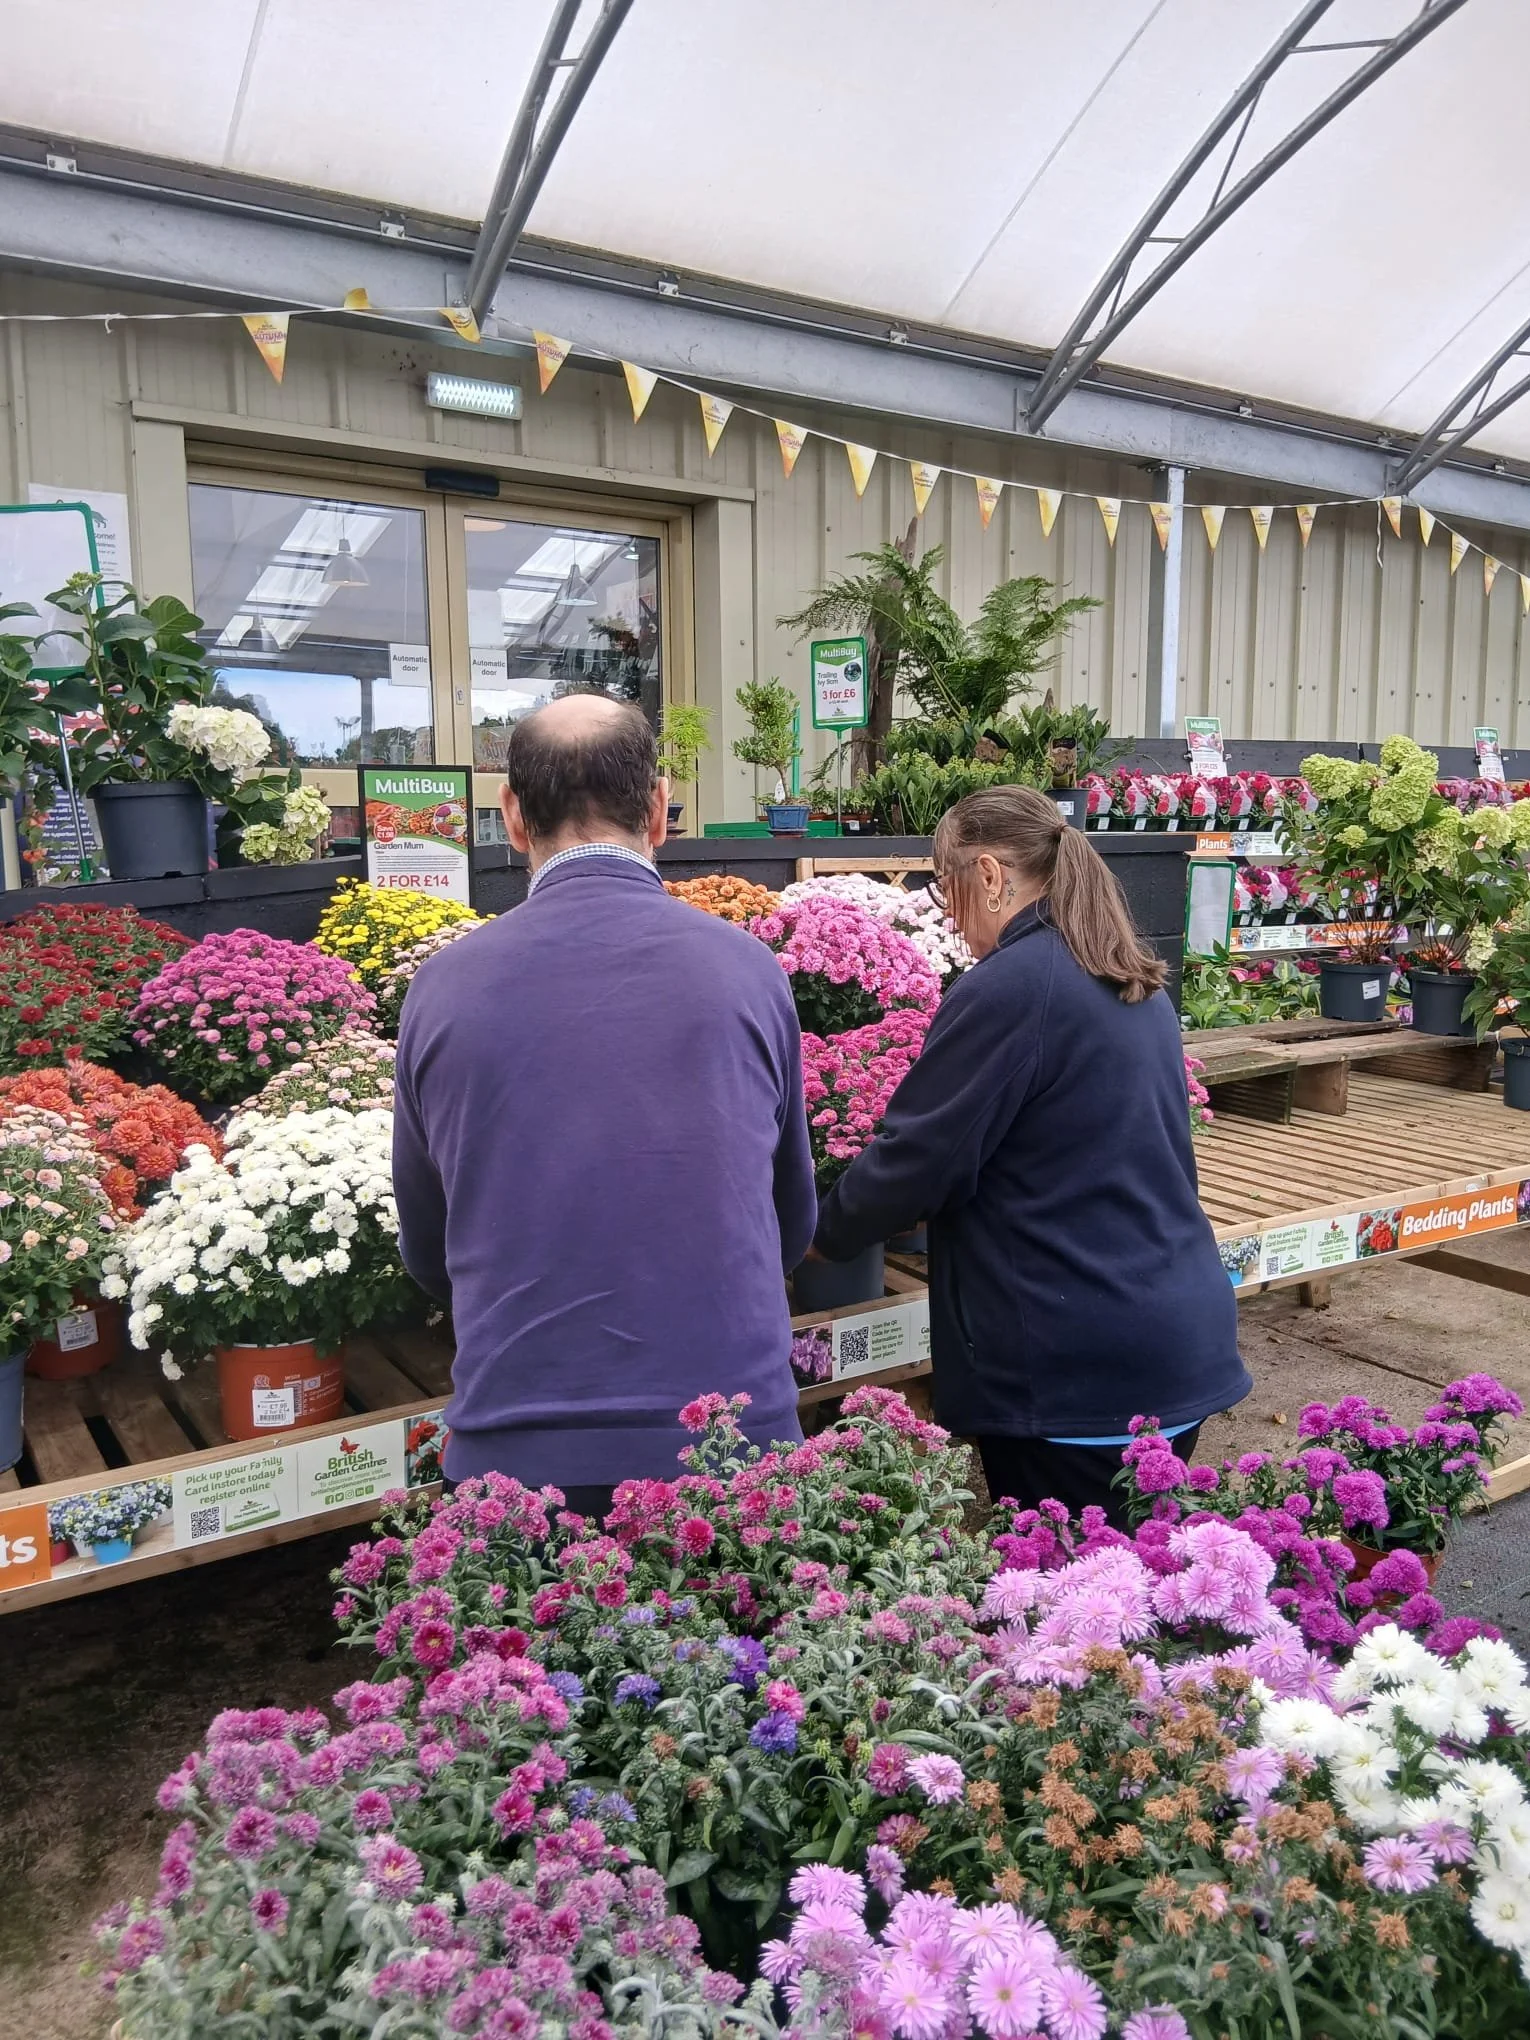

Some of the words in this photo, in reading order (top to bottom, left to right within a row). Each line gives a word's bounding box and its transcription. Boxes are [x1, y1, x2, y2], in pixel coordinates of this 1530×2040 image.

[820, 647, 857, 658] MultiBuy
[392, 654, 428, 664] Automatic
[472, 659, 505, 668] Automatic
[402, 664, 419, 672] door
[481, 668, 497, 676] door
[817, 671, 838, 680] Trailing
[822, 690, 828, 700] 3
[829, 690, 842, 699] for
[843, 688, 856, 698] £6
[375, 778, 455, 798] MultiBuy
[374, 842, 403, 850] Garden
[404, 842, 424, 850] Mum
[1199, 838, 1228, 850] Plants
[377, 875, 386, 888] 2
[389, 875, 421, 888] FOR
[424, 875, 450, 887] £14
[1402, 1206, 1467, 1236] Bedding
[1468, 1195, 1514, 1222] Plants
[1323, 1229, 1344, 1240] British
[328, 1448, 374, 1470] British
[186, 1473, 207, 1485] Pick
[209, 1470, 222, 1480] up
[224, 1464, 248, 1478] your
[314, 1467, 350, 1481] Garden
[351, 1457, 388, 1472] Centres
[184, 1483, 209, 1496] Card
[248, 1469, 276, 1483] today
[277, 1466, 284, 1475] &
[199, 1489, 237, 1505] register
[239, 1481, 271, 1495] online
